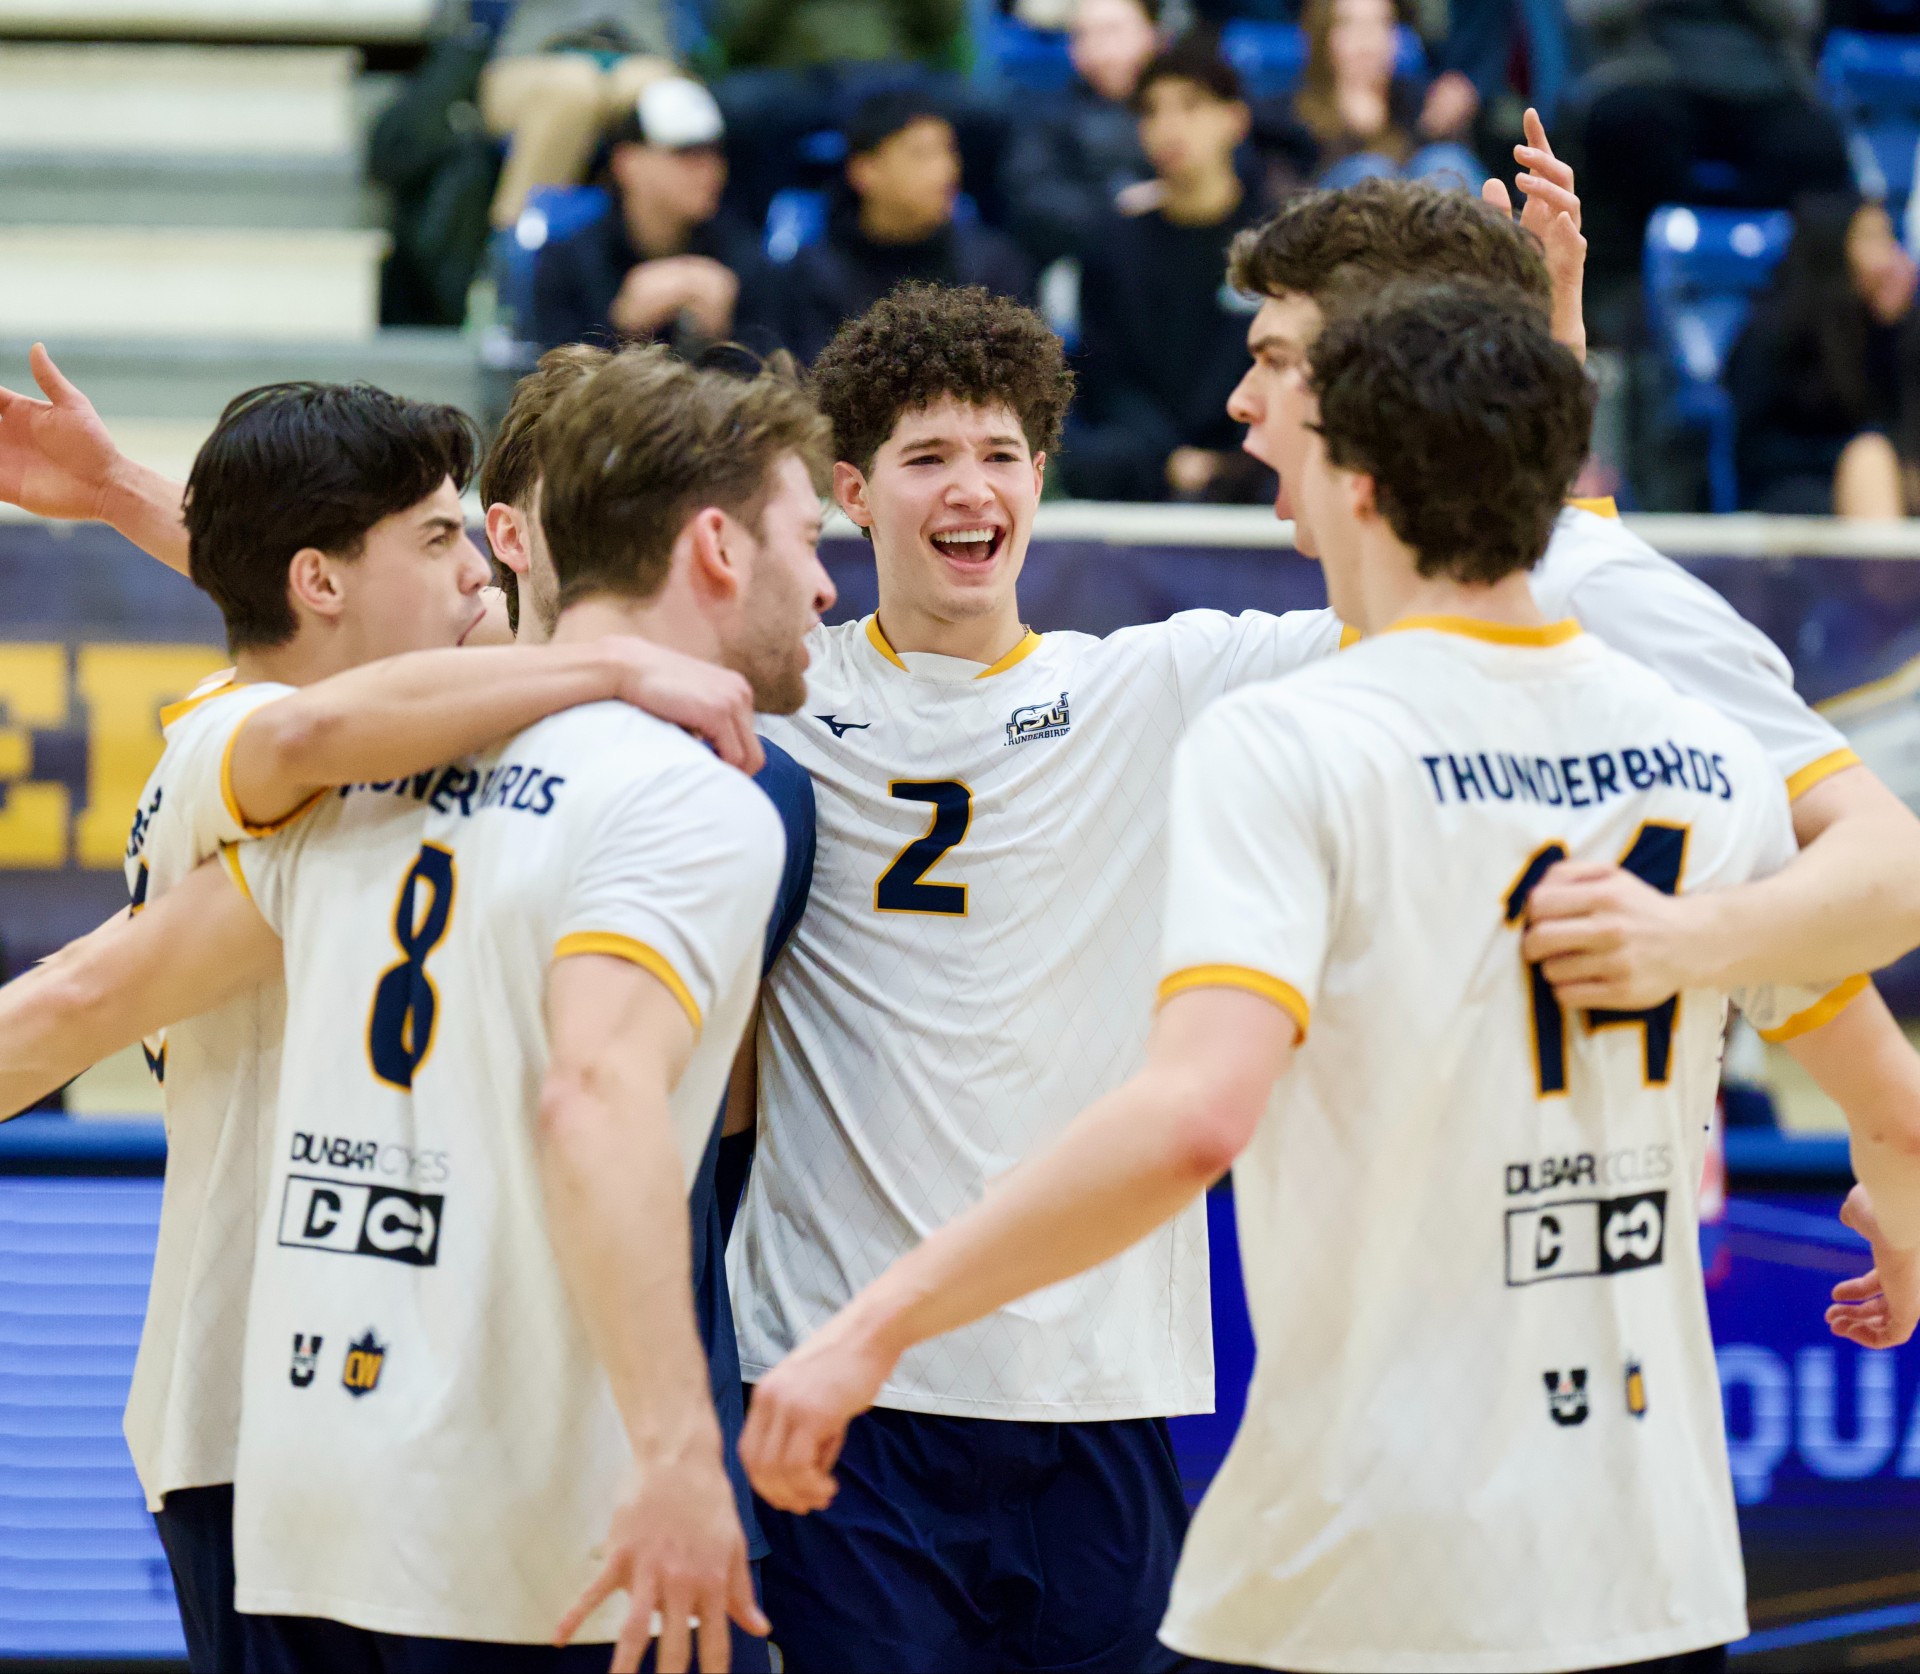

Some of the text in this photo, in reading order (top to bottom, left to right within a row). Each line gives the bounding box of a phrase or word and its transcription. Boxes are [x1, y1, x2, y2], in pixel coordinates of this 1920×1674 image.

[1003, 727, 1071, 747] HUNDERBIRDS
[873, 779, 975, 918] 2
[366, 840, 457, 1093] 8
[1501, 820, 1690, 1098] 14
[290, 1131, 379, 1171] DUNBAR
[1505, 1152, 1597, 1195] DUBAR
[1713, 1343, 1920, 1506] QU
